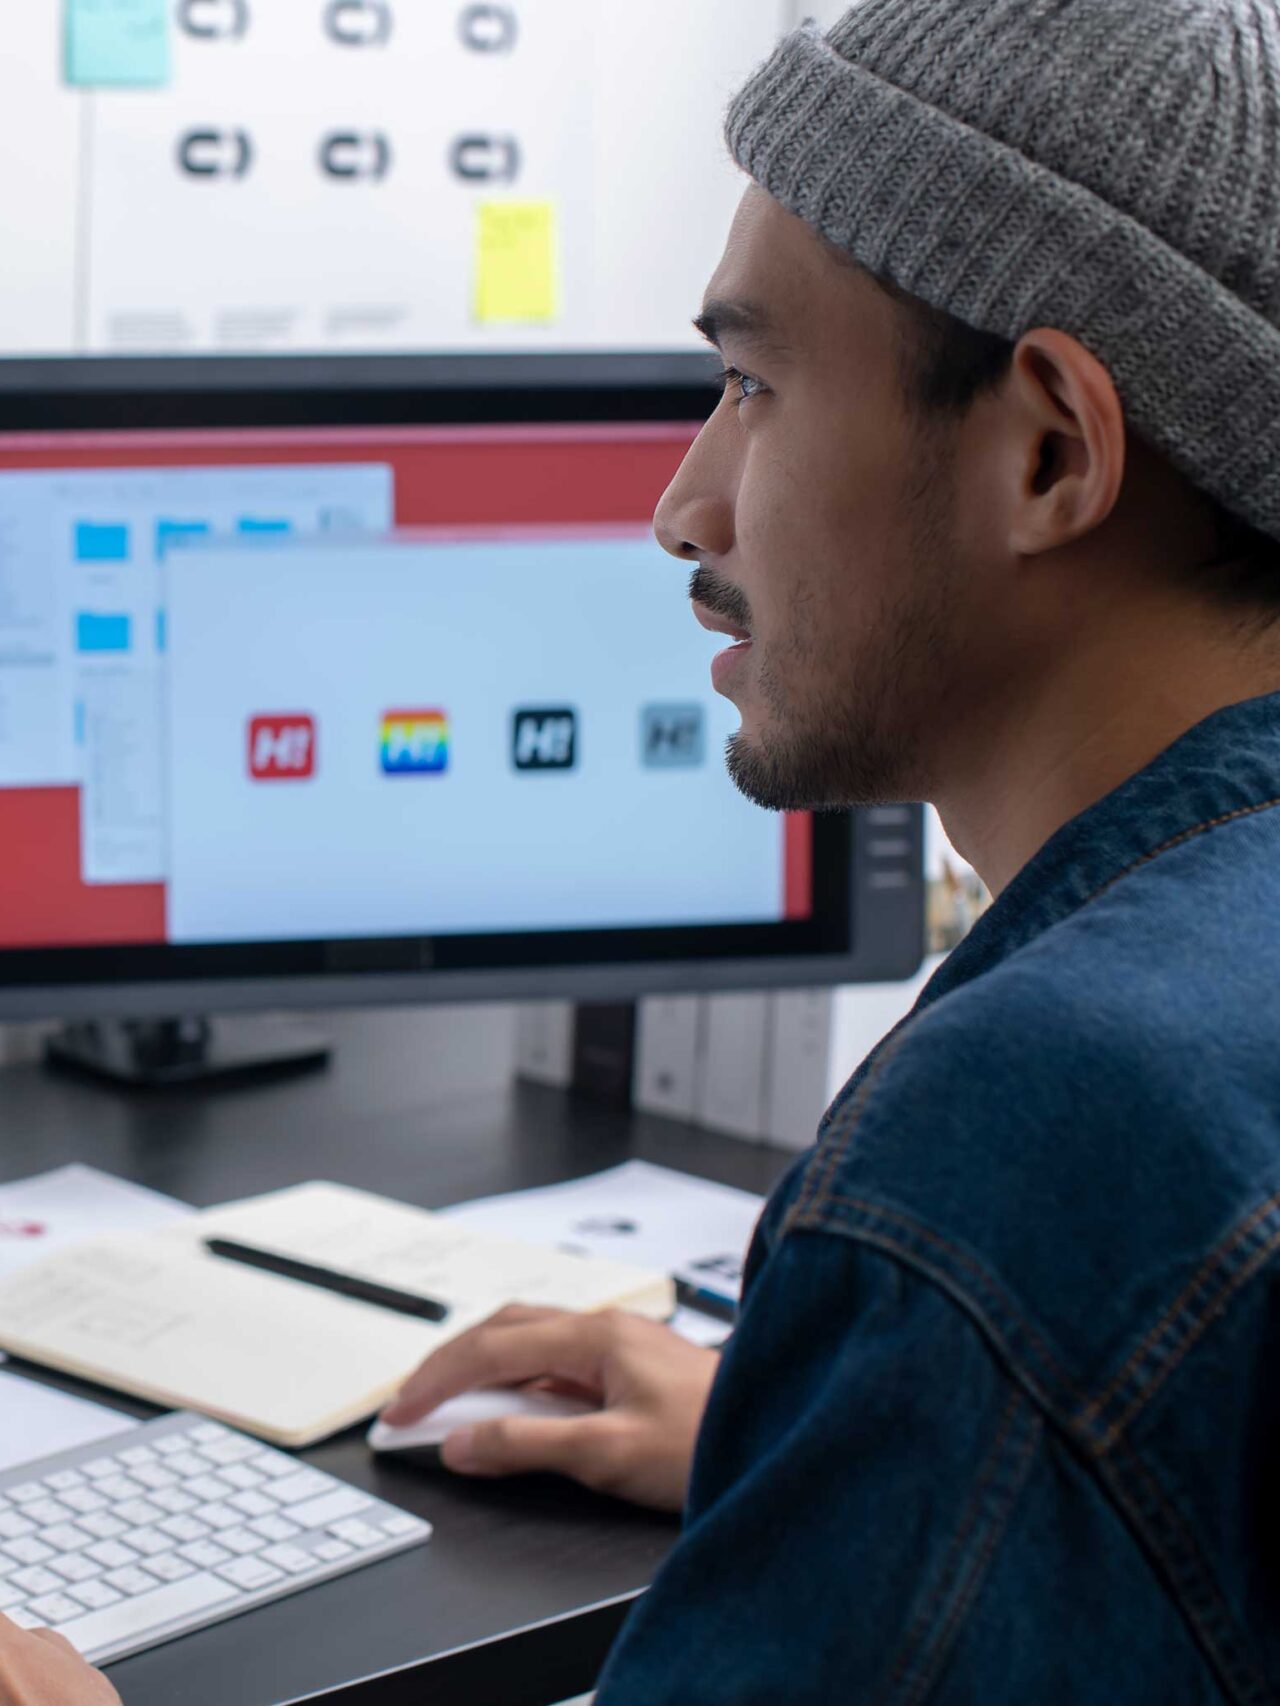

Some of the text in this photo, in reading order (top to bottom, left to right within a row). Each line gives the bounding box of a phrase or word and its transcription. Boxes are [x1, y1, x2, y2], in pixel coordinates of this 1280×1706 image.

[252, 727, 311, 769] H!
[385, 722, 443, 763] H!
[516, 718, 572, 761] H!
